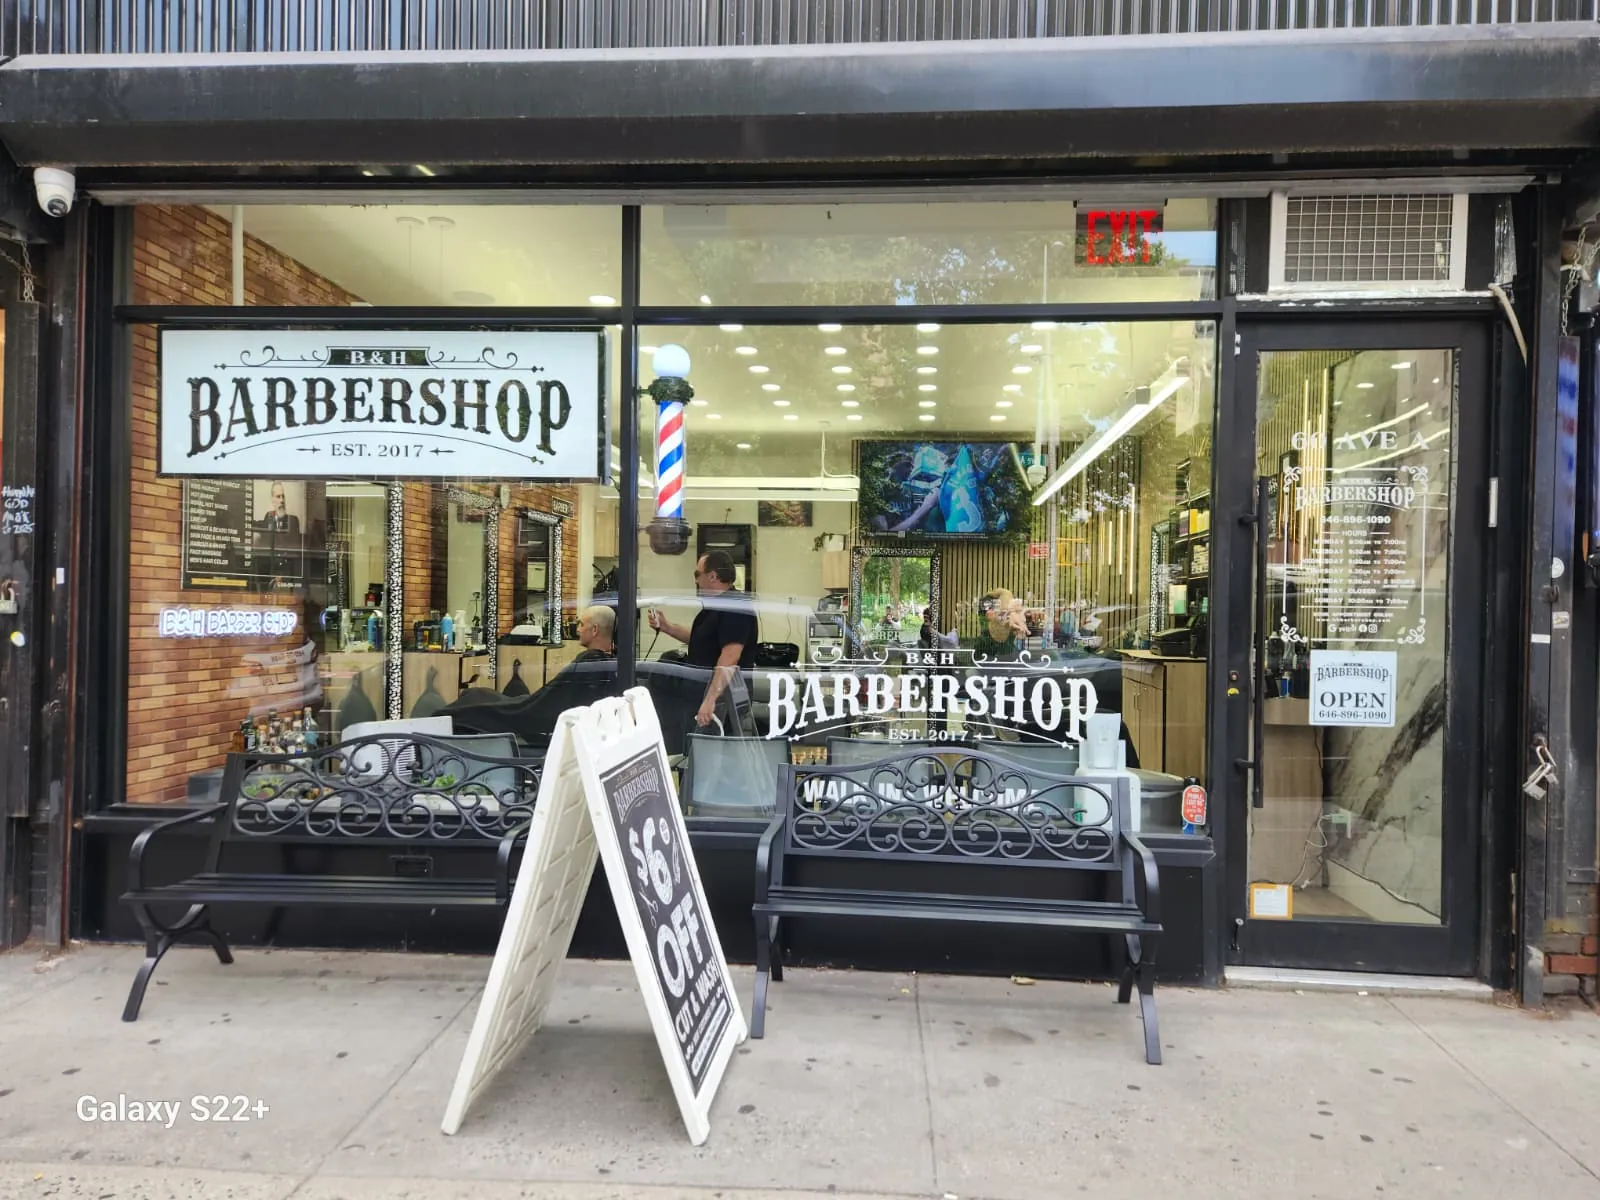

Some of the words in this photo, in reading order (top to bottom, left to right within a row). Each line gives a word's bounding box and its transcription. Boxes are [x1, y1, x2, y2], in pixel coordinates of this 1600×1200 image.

[1087, 210, 1157, 264] EXIT
[186, 376, 571, 458] BARBERSHOP
[331, 444, 371, 457] EST.
[378, 444, 423, 457] 2017
[1336, 431, 1399, 450] AVE
[1411, 431, 1430, 450] A
[1296, 486, 1415, 511] BARBERSHOP
[162, 609, 206, 636] B&H
[206, 609, 262, 635] BARBER
[906, 652, 955, 665] B&H
[1317, 667, 1389, 682] BARBERSHOP
[765, 671, 1098, 742] BARBERSHOP
[1320, 692, 1387, 708] OPEN
[1319, 710, 1387, 720] 646-896-1090
[888, 728, 927, 741] EST.
[929, 730, 968, 742] 2017
[613, 767, 660, 825] BARBERSHOP
[657, 892, 703, 998] OFF
[675, 999, 694, 1043] CUT
[695, 956, 721, 1005] WASH
